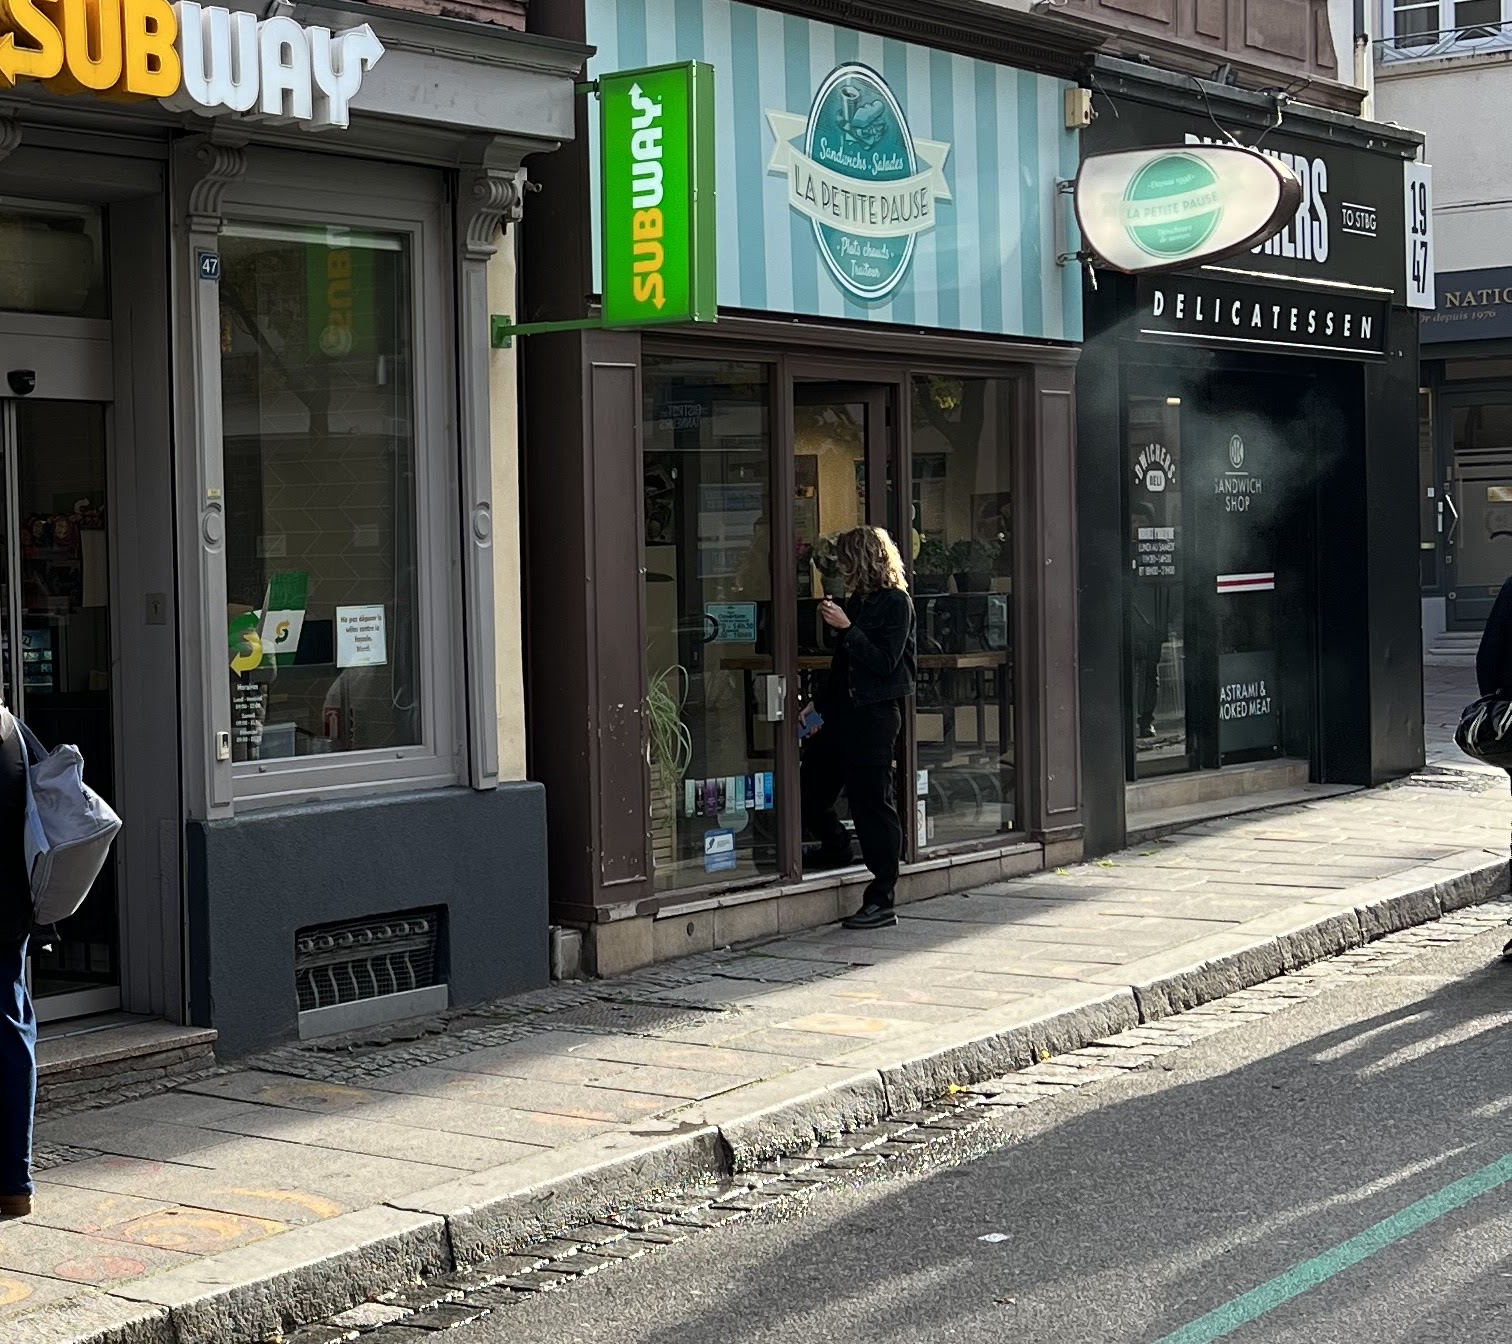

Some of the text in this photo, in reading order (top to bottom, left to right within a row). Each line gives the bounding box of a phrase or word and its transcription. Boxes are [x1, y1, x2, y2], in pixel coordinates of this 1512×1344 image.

[872, 152, 904, 175] Salades
[628, 82, 666, 311] SUBWAY
[795, 164, 929, 225] LA PETITE PAUSE
[1127, 191, 1217, 219] LA PETITE PAUSE
[1342, 209, 1377, 231] TO STBG
[1410, 181, 1427, 236] 19
[841, 236, 861, 257] Plats
[202, 258, 218, 274] 47
[1412, 239, 1428, 294] 47
[1153, 290, 1372, 339] DELICATESSEN
[1433, 311, 1468, 323] depuis
[1225, 496, 1250, 512] SHOP
[1249, 697, 1271, 716] MEAT
